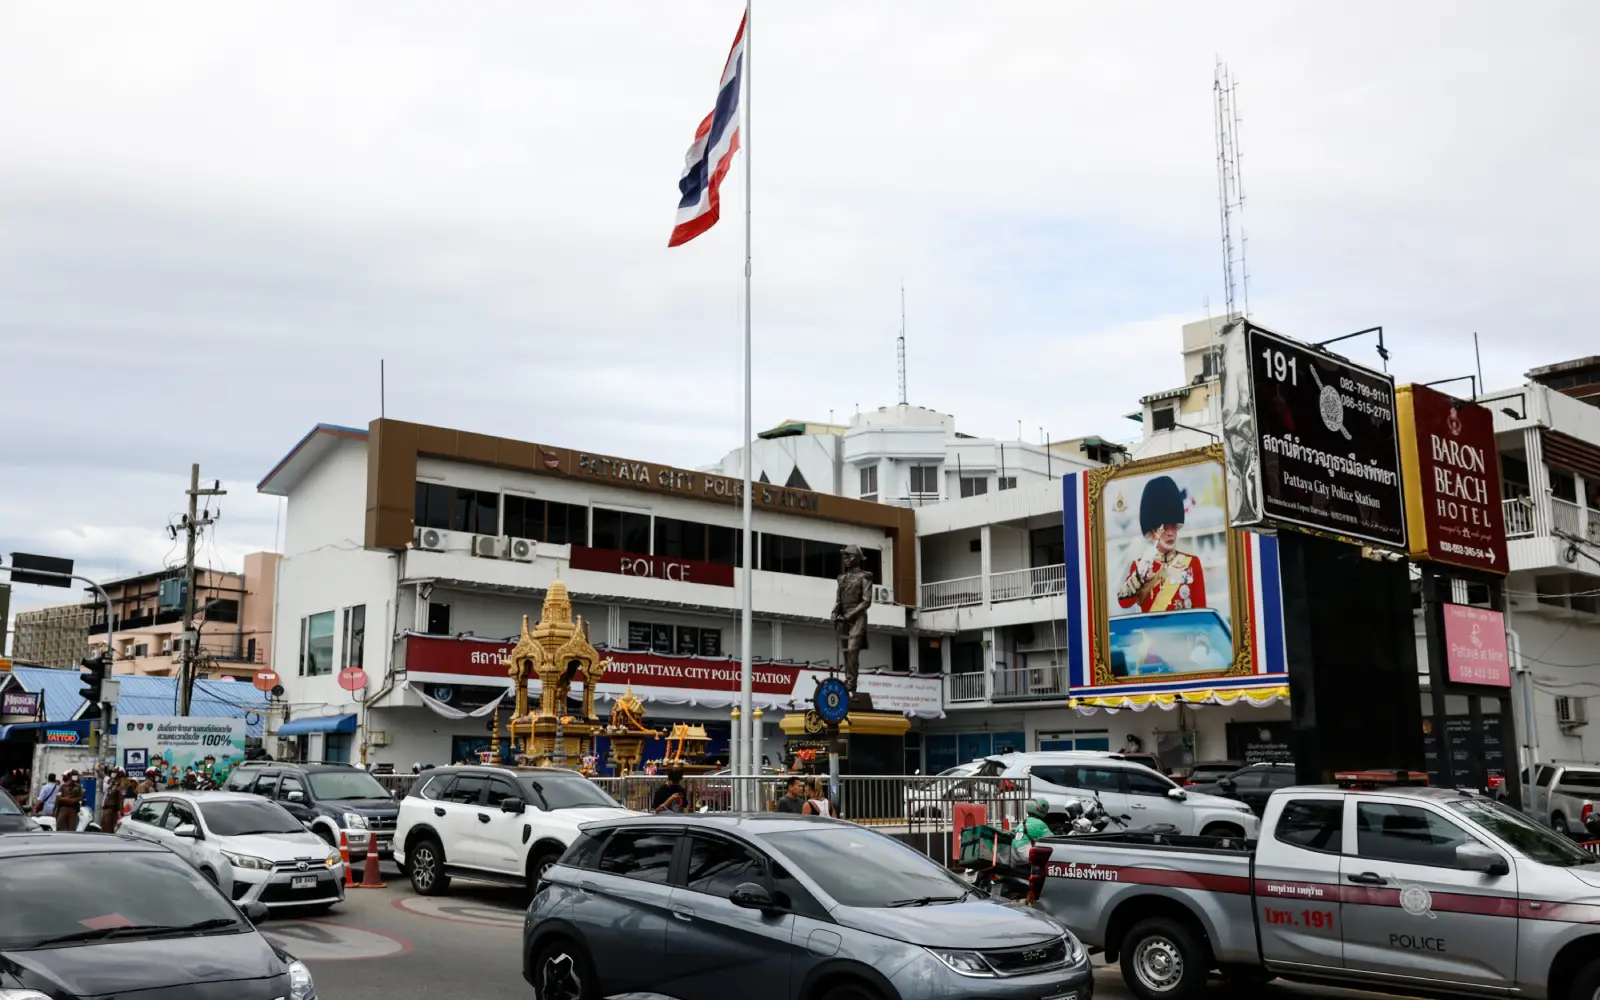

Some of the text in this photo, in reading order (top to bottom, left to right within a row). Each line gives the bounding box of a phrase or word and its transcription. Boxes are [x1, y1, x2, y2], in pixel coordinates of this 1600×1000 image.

[1263, 348, 1297, 387] 191
[1340, 377, 1389, 404] 082-799-9111
[1341, 394, 1391, 421] 086-515-2770
[1263, 433, 1397, 487] สถานีตำรวจภูธรเมืองพัทยา
[1430, 434, 1485, 474] BARON
[578, 454, 650, 483] PATTAYA
[658, 469, 694, 491] CITY
[762, 486, 820, 511] STATION
[1283, 471, 1381, 508] Pattaya City Police Station
[1433, 466, 1488, 505] BEACH
[1436, 498, 1491, 528] HOTEL
[620, 557, 691, 583] POLICE
[636, 663, 683, 678] PATTAYA
[684, 667, 710, 680] CITY
[711, 669, 743, 682] POLIC
[10, 706, 30, 714] BAR
[47, 734, 76, 742] TATTOO
[202, 734, 232, 746] 100%
[1048, 862, 1118, 881] สภ.เมืองพัทยา
[1302, 909, 1334, 931] 191
[1389, 933, 1446, 952] POLICE
